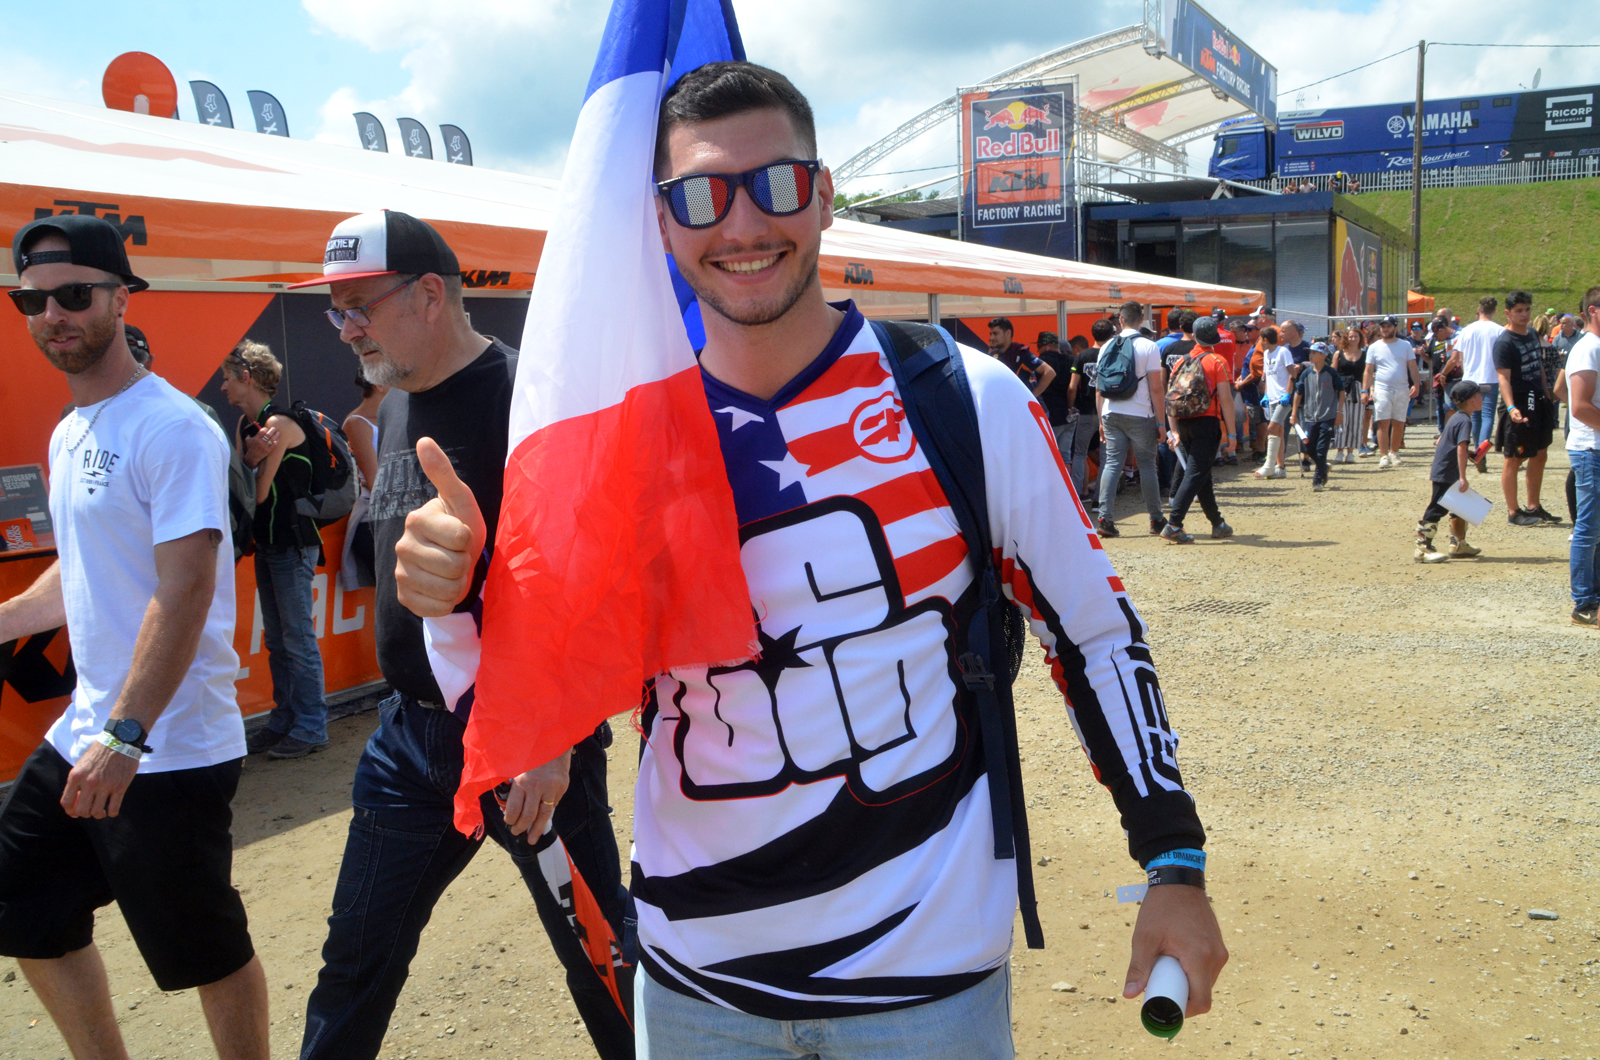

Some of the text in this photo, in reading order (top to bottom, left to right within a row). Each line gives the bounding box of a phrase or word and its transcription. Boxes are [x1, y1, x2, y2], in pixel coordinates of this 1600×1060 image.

[1200, 47, 1250, 98] KTM FACTORY RACING
[1546, 107, 1593, 118] TRICORP
[1296, 126, 1342, 140] WILVO
[976, 128, 1060, 159] Red Bull
[1387, 156, 1415, 168] Rev
[1443, 151, 1470, 160] Heart
[988, 168, 1050, 194] KTM
[977, 204, 1061, 221] FACTORY RACING
[843, 262, 874, 285] KTM
[1003, 276, 1024, 294] KTM
[83, 449, 120, 473] RIDE
[2, 473, 37, 483] AUTOGRAPH
[4, 481, 30, 490] SESSION
[1173, 851, 1201, 863] DIMANCHE
